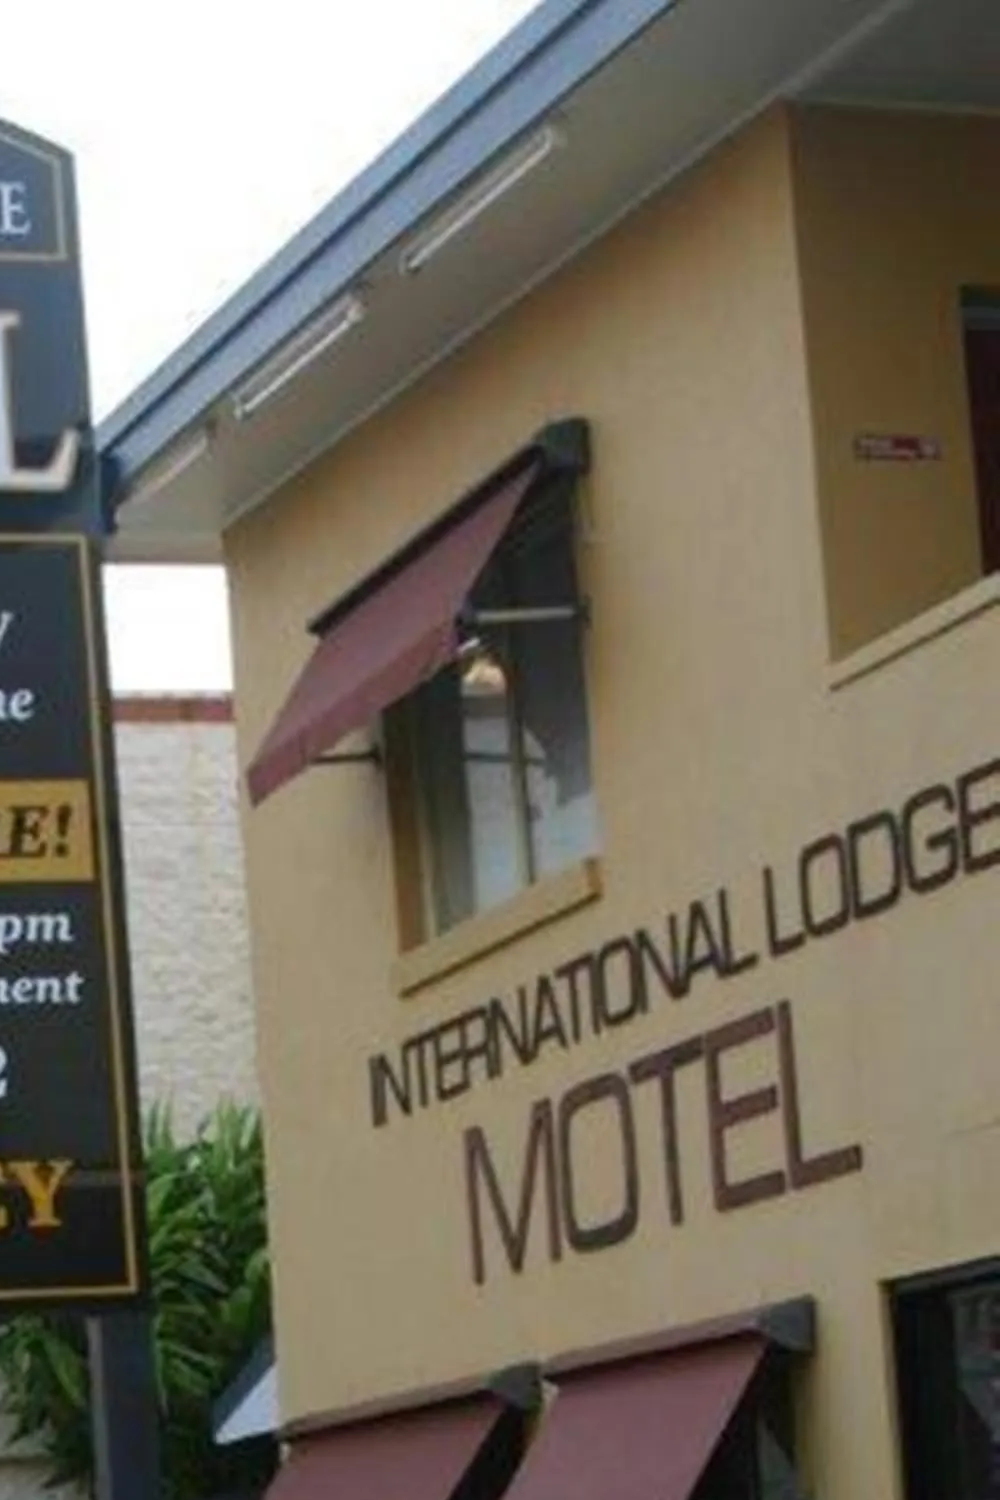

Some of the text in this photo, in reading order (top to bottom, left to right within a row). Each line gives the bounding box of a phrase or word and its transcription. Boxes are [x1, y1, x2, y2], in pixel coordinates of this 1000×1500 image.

[368, 756, 1000, 1128] INTERNATIONAL LODGE
[462, 1000, 864, 1286] MOTEL
